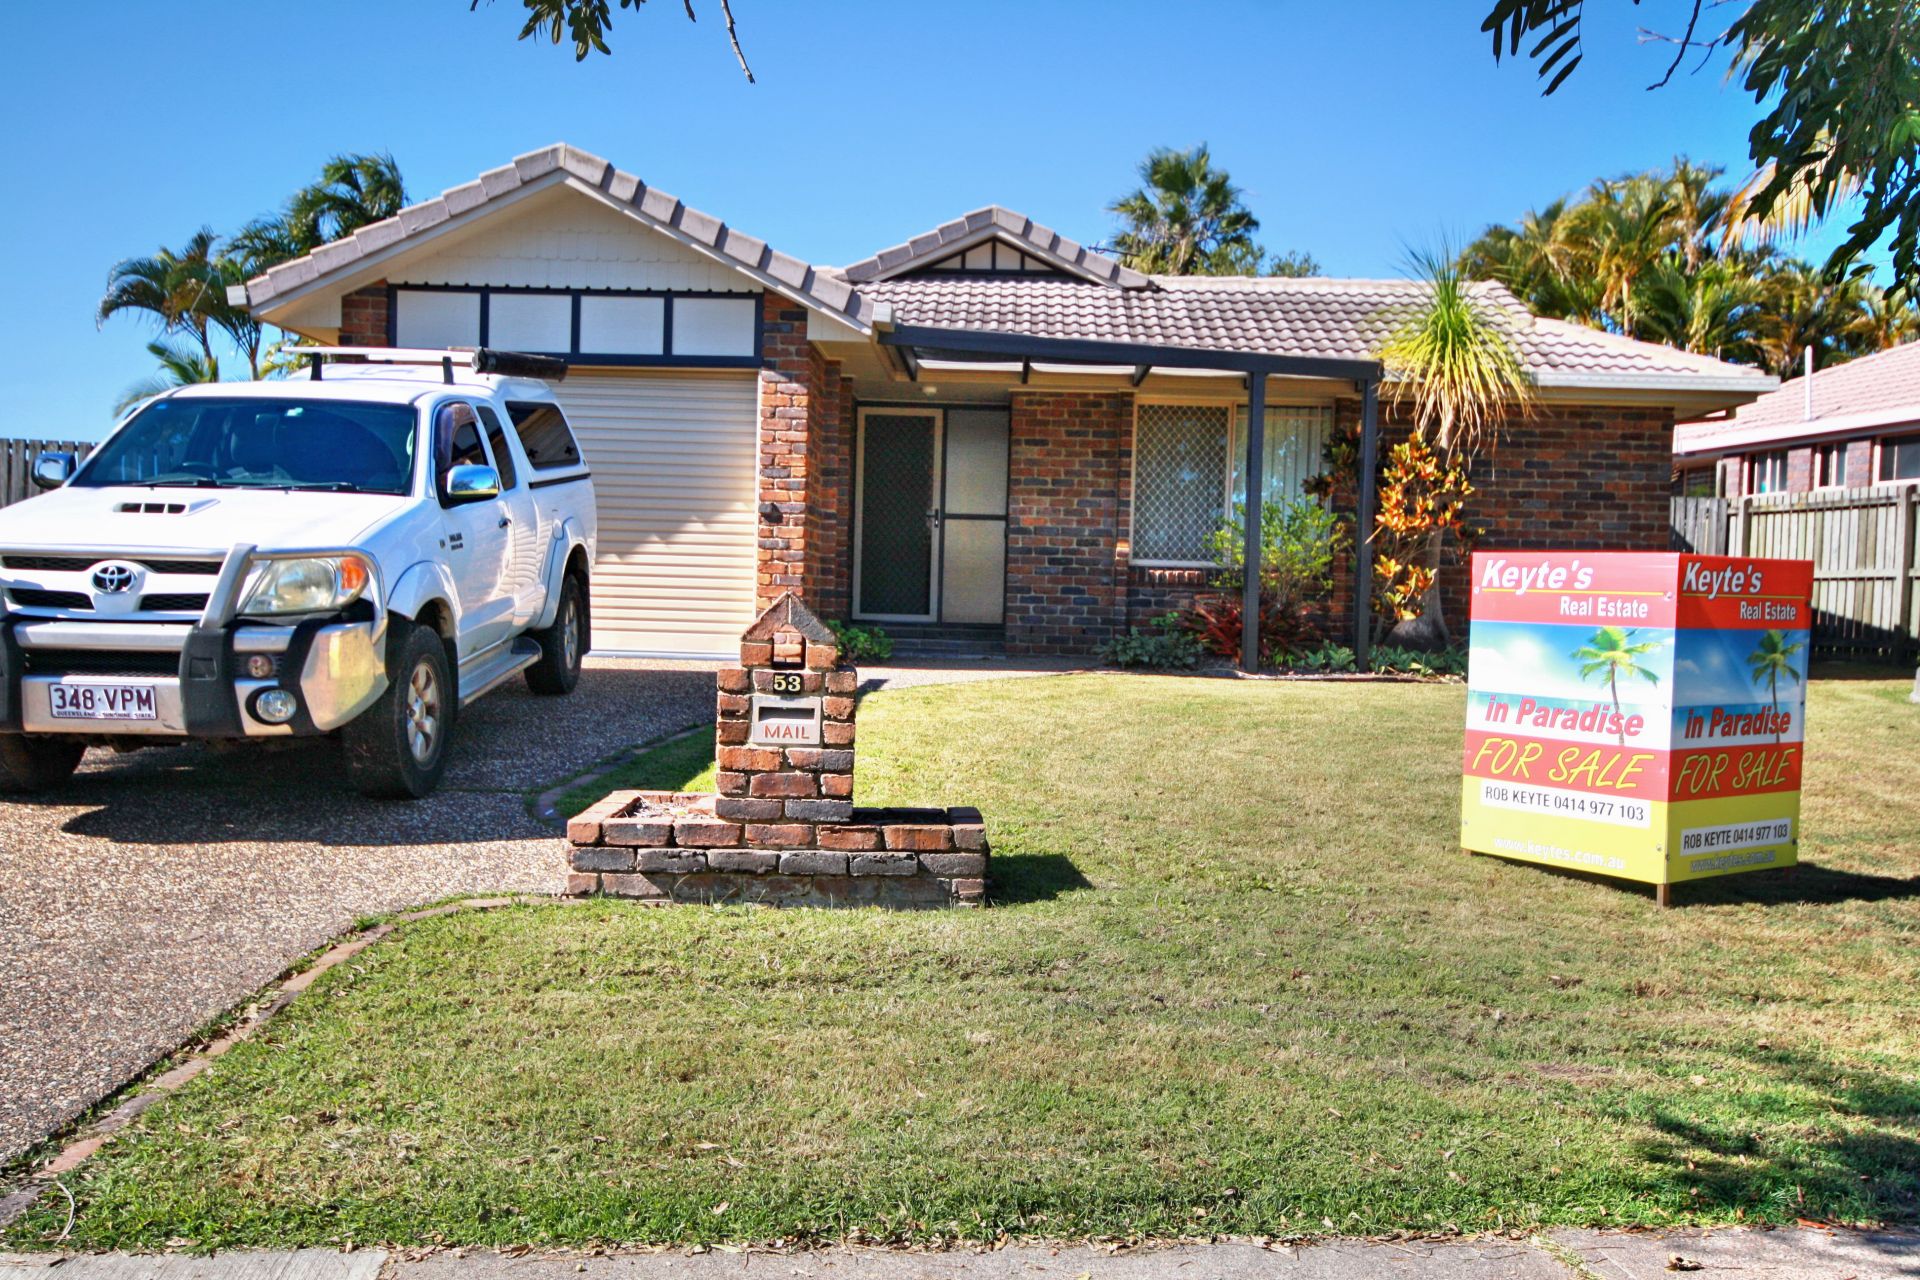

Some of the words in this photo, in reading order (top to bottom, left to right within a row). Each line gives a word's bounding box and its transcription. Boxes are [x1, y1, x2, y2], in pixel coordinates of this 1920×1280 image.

[1481, 559, 1594, 595] Keyte's
[1682, 561, 1763, 600] Keyte's
[1560, 596, 1592, 616] Real
[1597, 597, 1648, 618] Estate
[1740, 601, 1762, 620] Real
[1764, 601, 1797, 620] Estate
[773, 675, 801, 692] 53
[764, 725, 810, 739] MAIL
[1484, 695, 1509, 723] in
[1516, 697, 1644, 737] Paradise
[1684, 708, 1704, 739] in
[1708, 705, 1791, 737] Paradise
[1472, 737, 1543, 779] FOR
[1548, 747, 1655, 789] SALE
[1675, 753, 1729, 794] FOR
[1732, 748, 1796, 789] SALE
[1485, 786, 1508, 801] ROB
[1512, 790, 1550, 807] KEYTE
[1554, 795, 1585, 812] 0414
[1589, 800, 1614, 816] 977
[1620, 805, 1644, 821] 103
[1493, 837, 1625, 870] www.keytes.com.au
[1683, 833, 1702, 850] ROB
[1704, 829, 1731, 847] KEYTE
[1733, 828, 1754, 843] 0414
[1756, 826, 1771, 840] 977
[1773, 823, 1787, 838] 103
